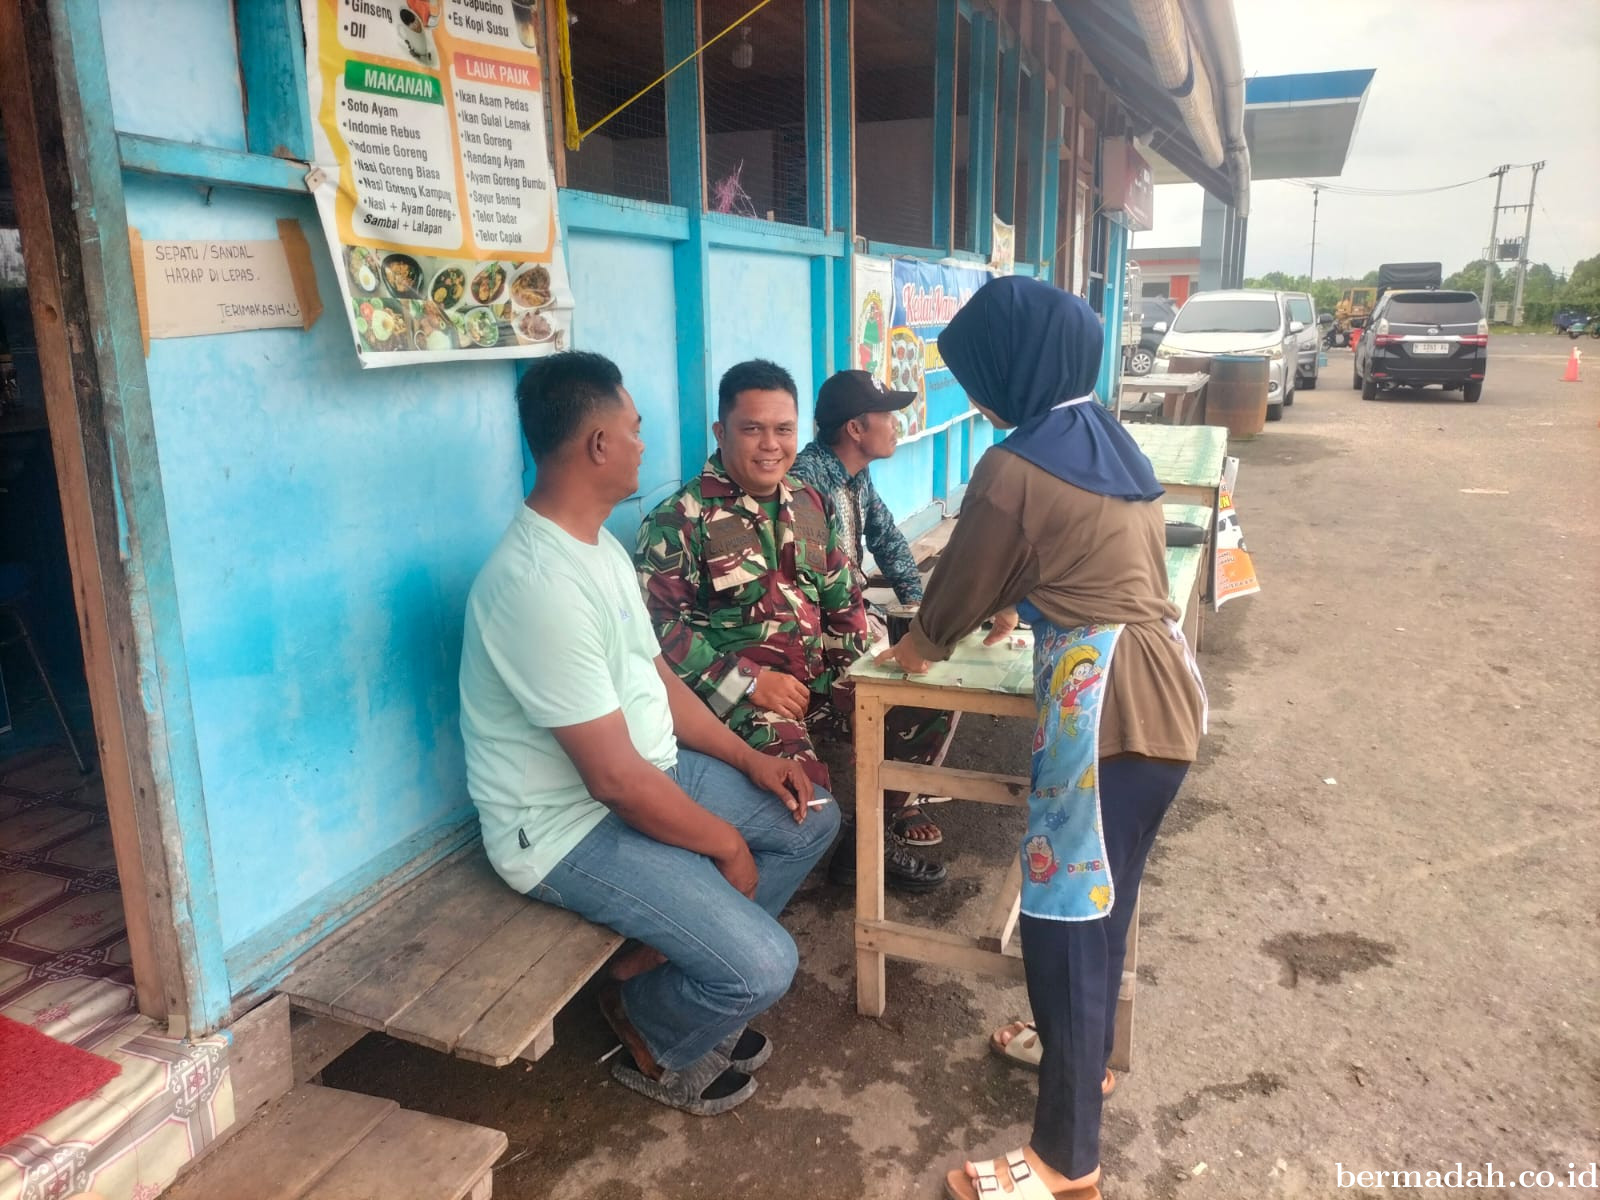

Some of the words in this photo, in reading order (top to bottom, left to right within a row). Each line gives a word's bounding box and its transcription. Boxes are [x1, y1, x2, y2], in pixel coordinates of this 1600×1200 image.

[352, 0, 392, 23] Ginseng
[453, 12, 463, 26] Es
[465, 16, 484, 35] Kopi
[486, 21, 508, 37] Susu
[466, 59, 497, 80] LAUK
[499, 65, 530, 86] PAUK
[364, 69, 433, 98] MAKANAN
[347, 98, 369, 113] Soto
[371, 102, 398, 118] Ayam
[459, 89, 477, 104] Ikan
[479, 93, 503, 108] Asam
[504, 97, 529, 112] Pedas
[348, 118, 388, 136] Indomie
[390, 124, 421, 139] Rebus
[461, 109, 479, 125] Ikan
[480, 112, 503, 128] Gulai
[504, 116, 531, 131] Lemak
[463, 130, 481, 144] Ikan
[483, 133, 512, 151] Goreng
[392, 144, 428, 161] Goreng
[466, 150, 502, 168] Rendang
[503, 155, 525, 170] Ayam
[357, 158, 377, 173] Nasi
[378, 162, 414, 179] Goreng
[416, 166, 441, 180] Biasa
[363, 177, 384, 191] Nasi
[385, 180, 418, 198] Goreng
[470, 170, 491, 186] Ayam
[492, 173, 520, 190] Goreng
[368, 196, 386, 210] Nasi
[401, 201, 424, 216] Ayam
[472, 190, 494, 206] Sayur
[363, 213, 399, 230] Sambal
[412, 220, 442, 235] Lalapan
[475, 210, 494, 223] Telor
[479, 229, 498, 242] Telor
[156, 245, 199, 262] SEPATU
[210, 245, 255, 260] SANDAL
[165, 267, 204, 284] HARAP
